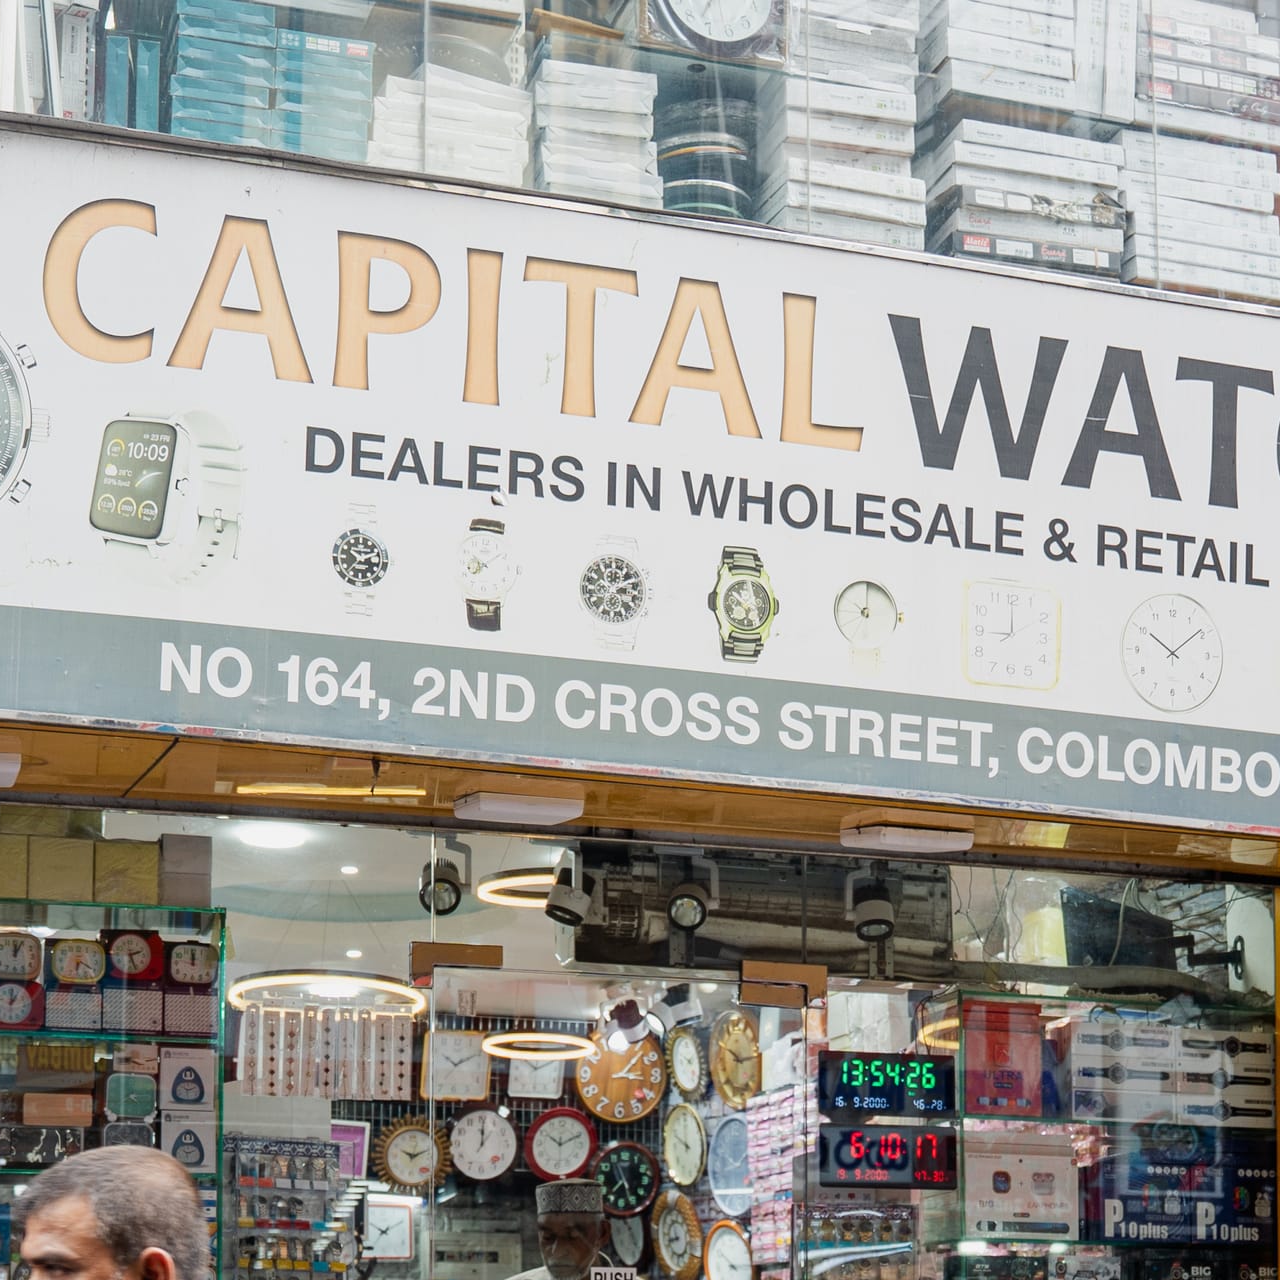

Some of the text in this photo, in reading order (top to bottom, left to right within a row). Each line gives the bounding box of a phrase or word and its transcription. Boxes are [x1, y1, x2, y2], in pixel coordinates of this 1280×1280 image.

[42, 198, 865, 452] CAPITAL
[127, 442, 169, 462] 10:09
[305, 426, 1270, 587] DEALERS IN WHOLESALE & RETAIL
[160, 641, 254, 698] NO
[277, 654, 391, 721] 164,
[411, 667, 535, 723] 2ND
[555, 680, 762, 745] CROSS
[778, 701, 1001, 778] STREET,
[842, 1060, 936, 1088] 13:54:26
[850, 1131, 938, 1159] 6:10:17
[1191, 1267, 1211, 1276] BIG
